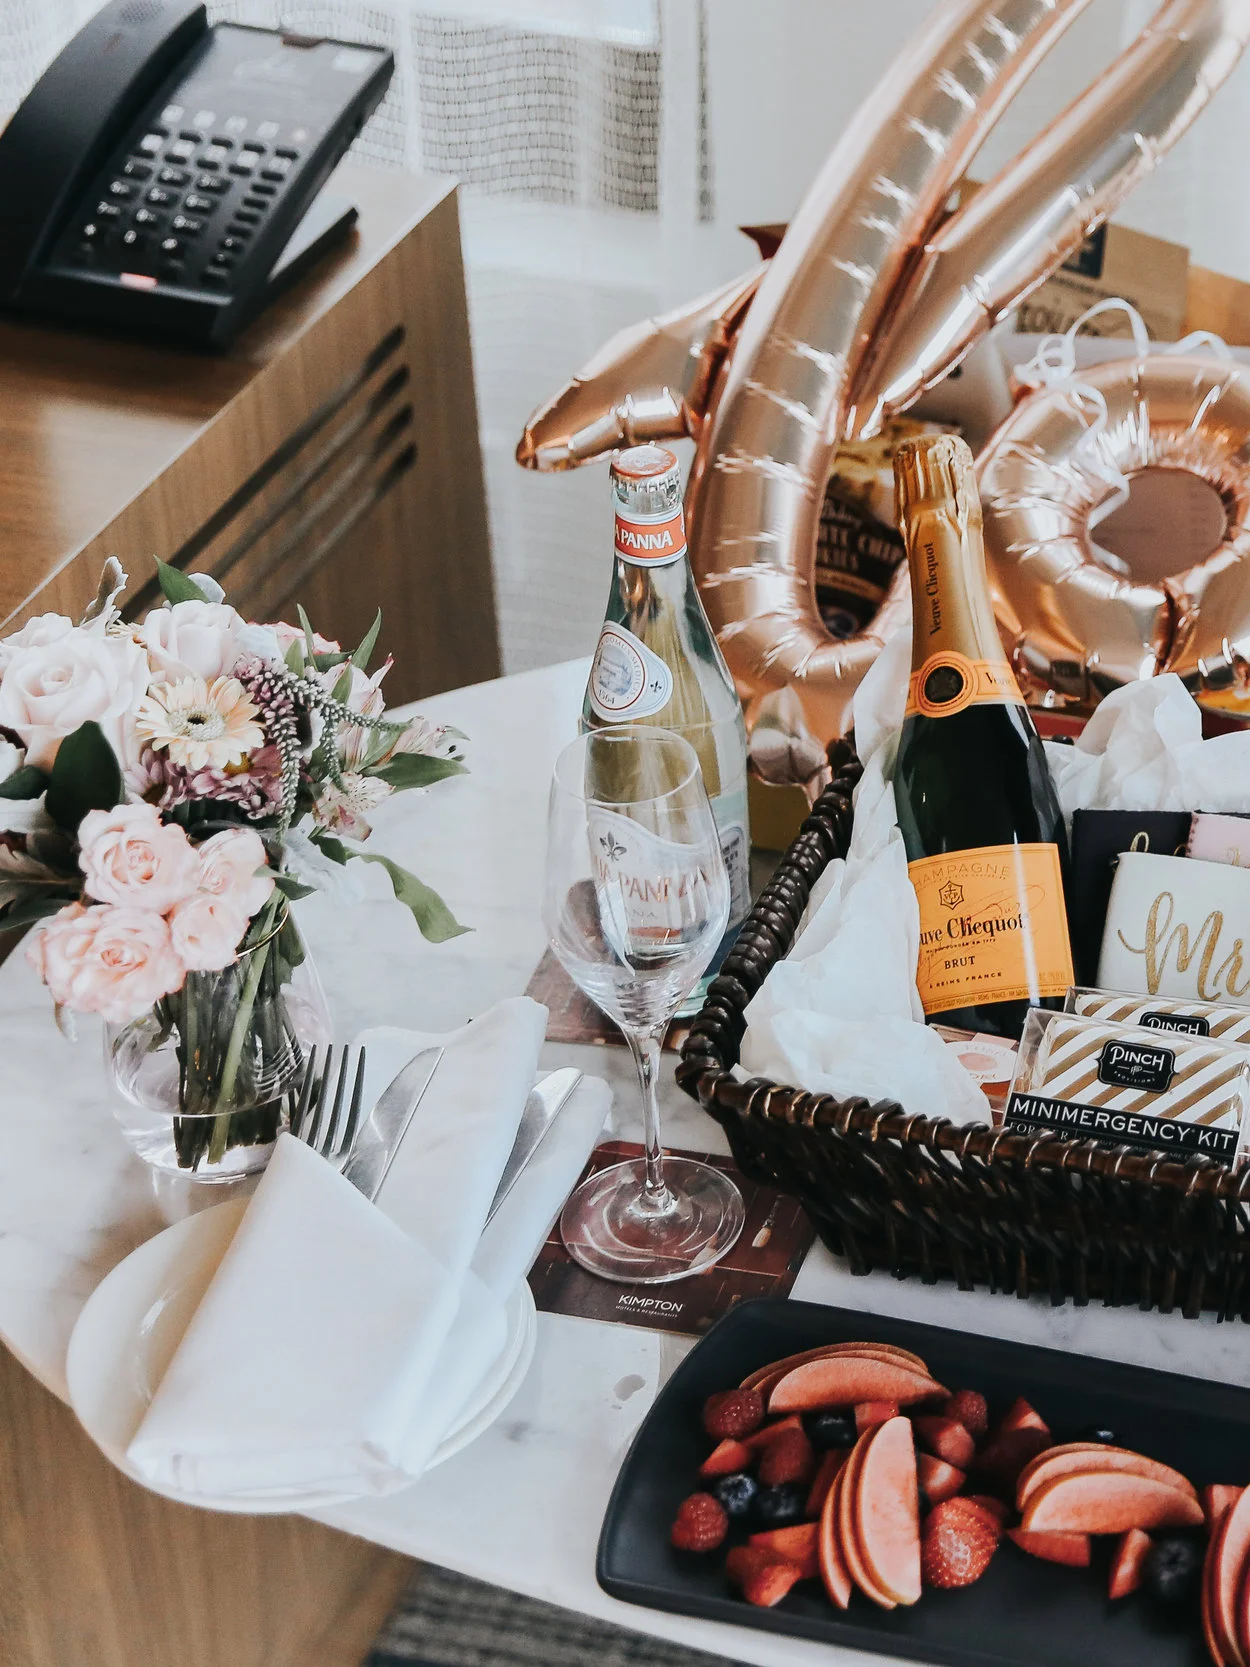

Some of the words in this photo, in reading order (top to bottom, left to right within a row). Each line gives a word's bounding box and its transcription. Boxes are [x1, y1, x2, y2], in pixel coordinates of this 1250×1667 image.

[620, 528, 674, 550] PANNA
[923, 541, 939, 597] Clicquot
[929, 598, 942, 636] Veuve
[914, 863, 1012, 886] HAMPAGNE
[919, 928, 943, 945] uve
[944, 955, 976, 970] BRUT
[965, 971, 1002, 982] FRANCE
[1110, 1045, 1166, 1072] PINCH
[1113, 1070, 1156, 1084] PROVISIONS
[1012, 1097, 1193, 1142] MINIMERGENCY
[1199, 1128, 1234, 1151] KIT
[618, 1294, 683, 1313] KIMPTON
